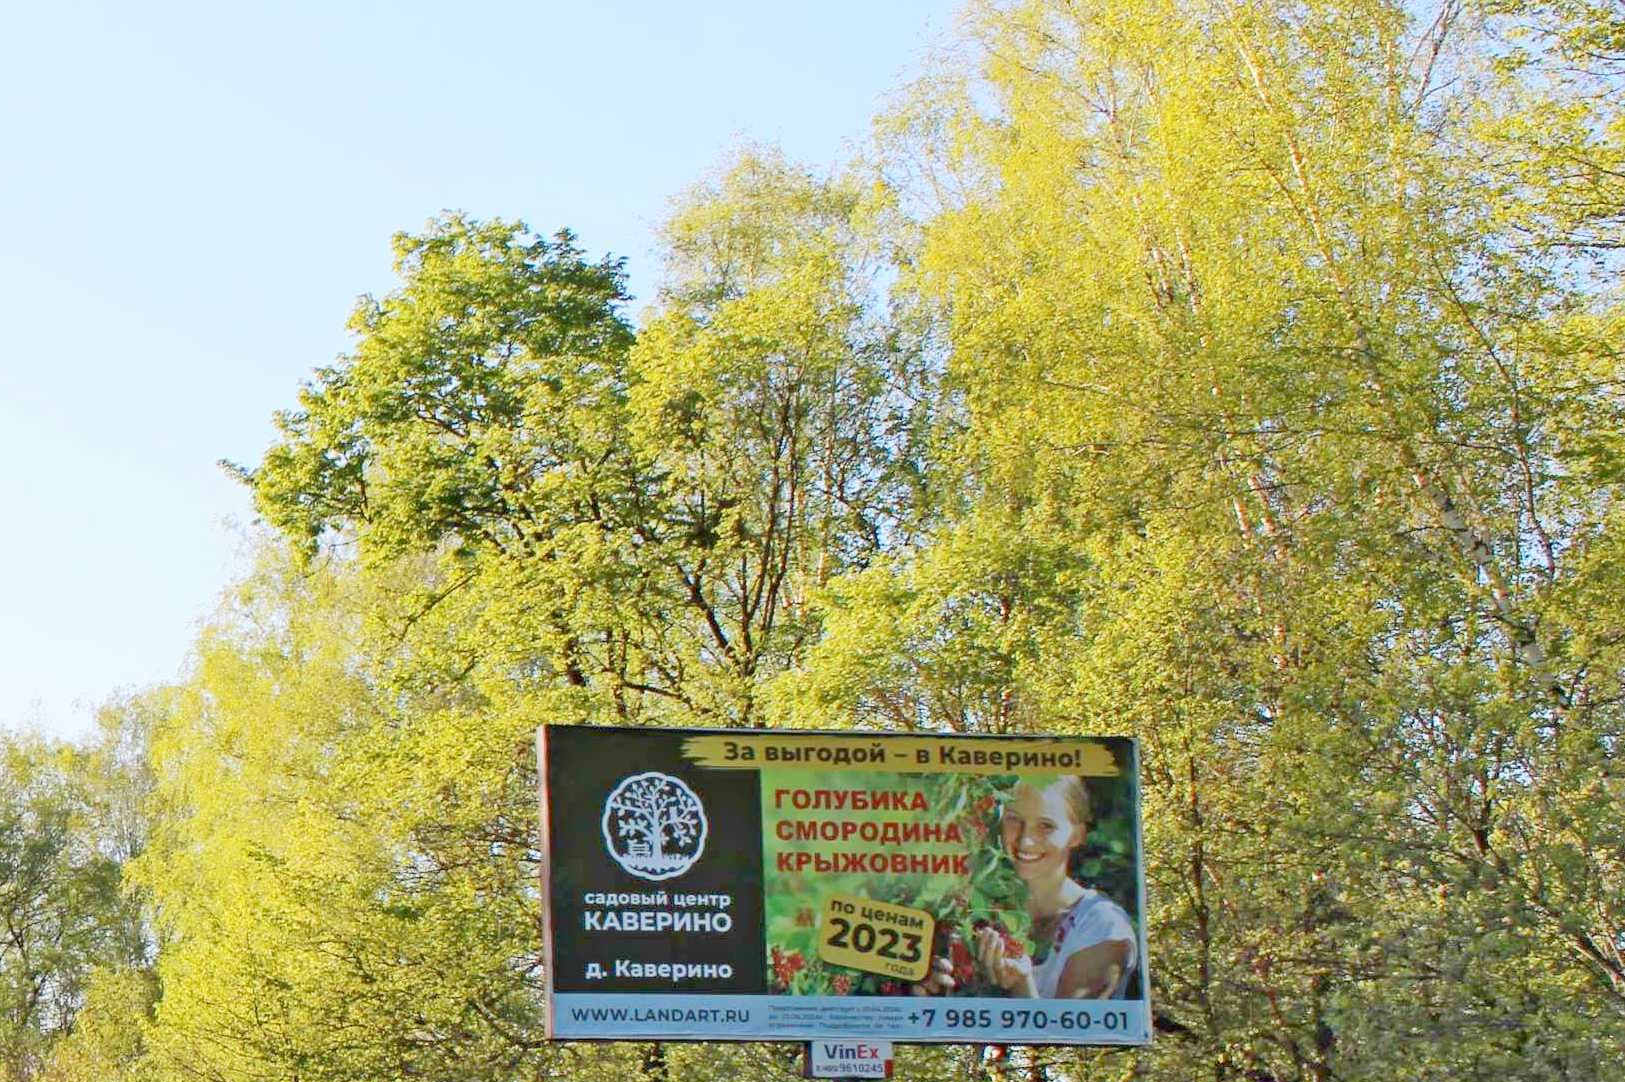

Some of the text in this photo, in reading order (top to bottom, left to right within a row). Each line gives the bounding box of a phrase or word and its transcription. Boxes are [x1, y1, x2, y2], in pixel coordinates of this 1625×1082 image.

[723, 742, 756, 762] За
[765, 742, 886, 764] выгодой
[916, 749, 930, 764] в
[939, 746, 1082, 769] Каверино!
[775, 789, 928, 812] ГОЛУБИКА
[776, 820, 963, 846] СМОРОДИНА
[777, 852, 969, 876] КРЫЖОВНИК
[584, 891, 731, 909] садовый центр
[584, 911, 732, 933] КАВЕРИНО
[831, 900, 924, 930] по ценам
[827, 918, 922, 963] 2023
[585, 959, 732, 982] д. Каверино
[571, 1007, 750, 1024] WWW.LANDART.RU
[907, 1009, 1128, 1030] +7 985 970-60-01
[824, 1044, 879, 1059] VinEx
